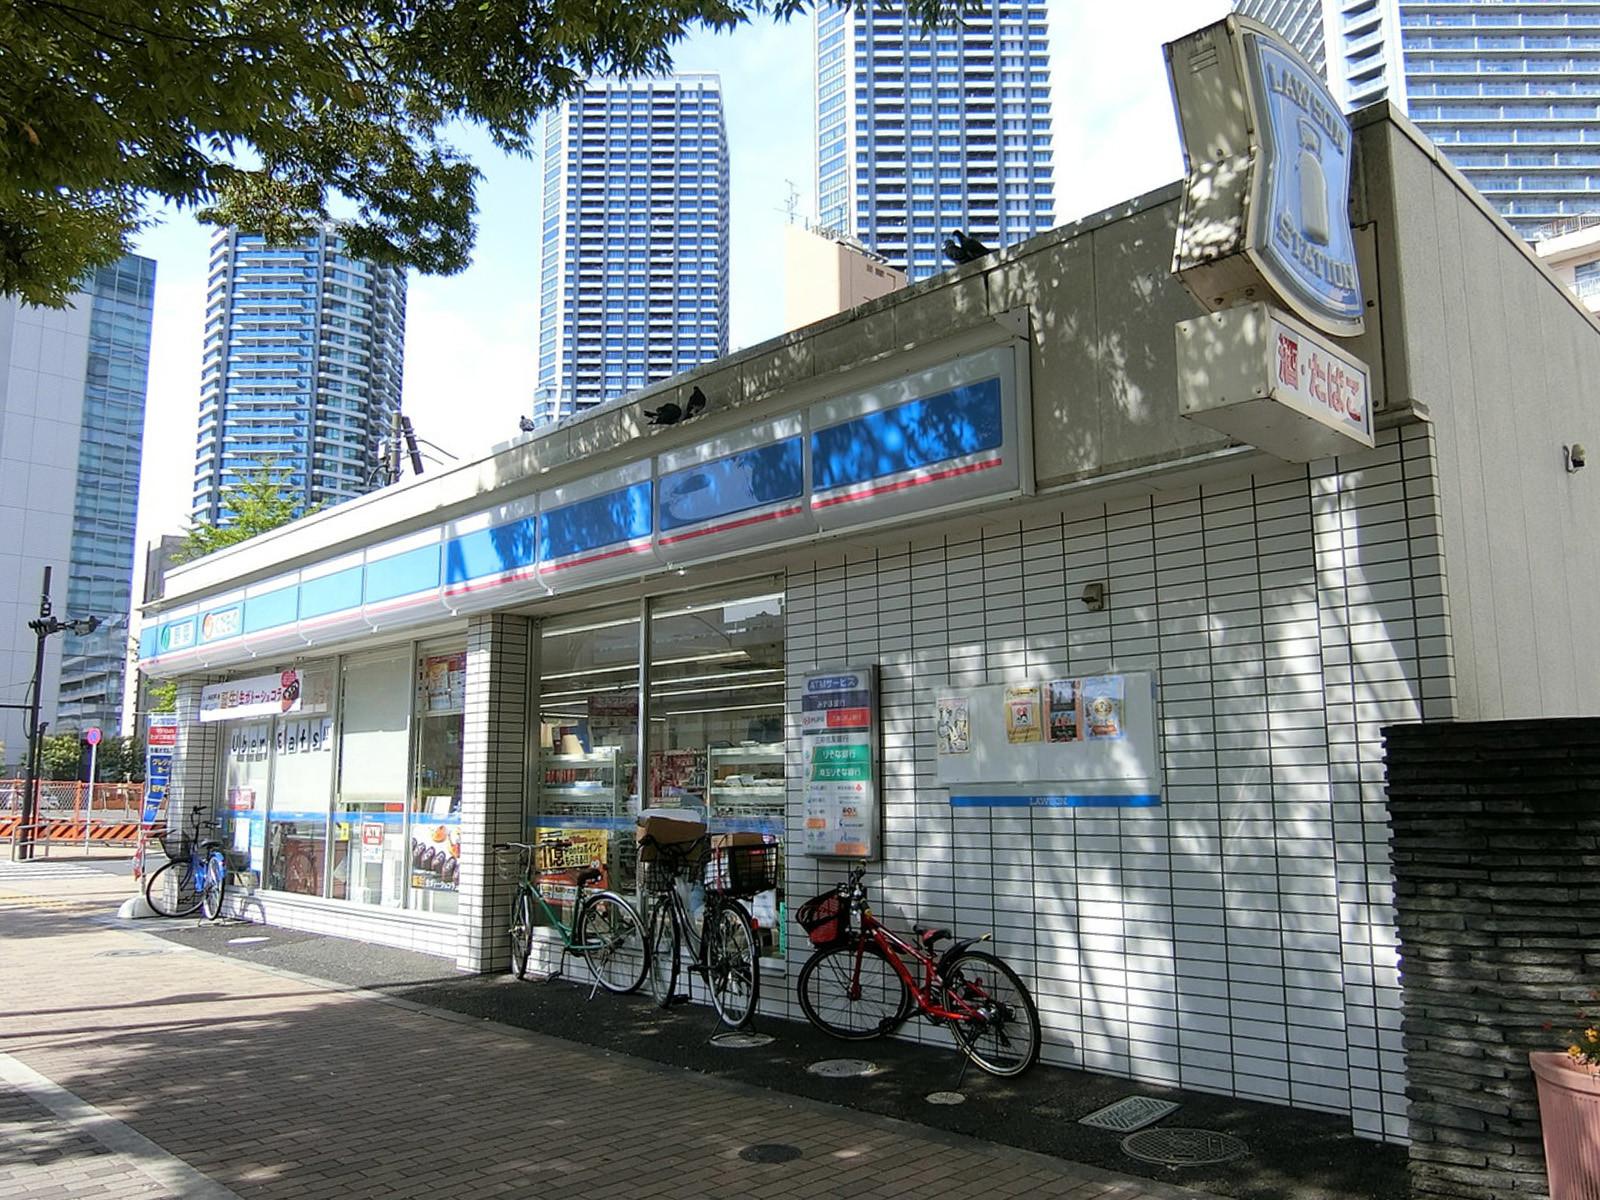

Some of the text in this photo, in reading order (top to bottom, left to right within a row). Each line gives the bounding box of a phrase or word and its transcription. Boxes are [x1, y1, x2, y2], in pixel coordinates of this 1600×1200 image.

[1268, 62, 1344, 155] LAWSON
[1277, 212, 1355, 290] STATION
[1278, 333, 1361, 422] 酒・たばこ
[809, 677, 856, 690] ATMサービス
[232, 734, 266, 753] Uber
[822, 749, 856, 759] りそな銀行
[819, 767, 861, 777] 埼玉りそな銀行
[1029, 797, 1067, 806] LAWSON
